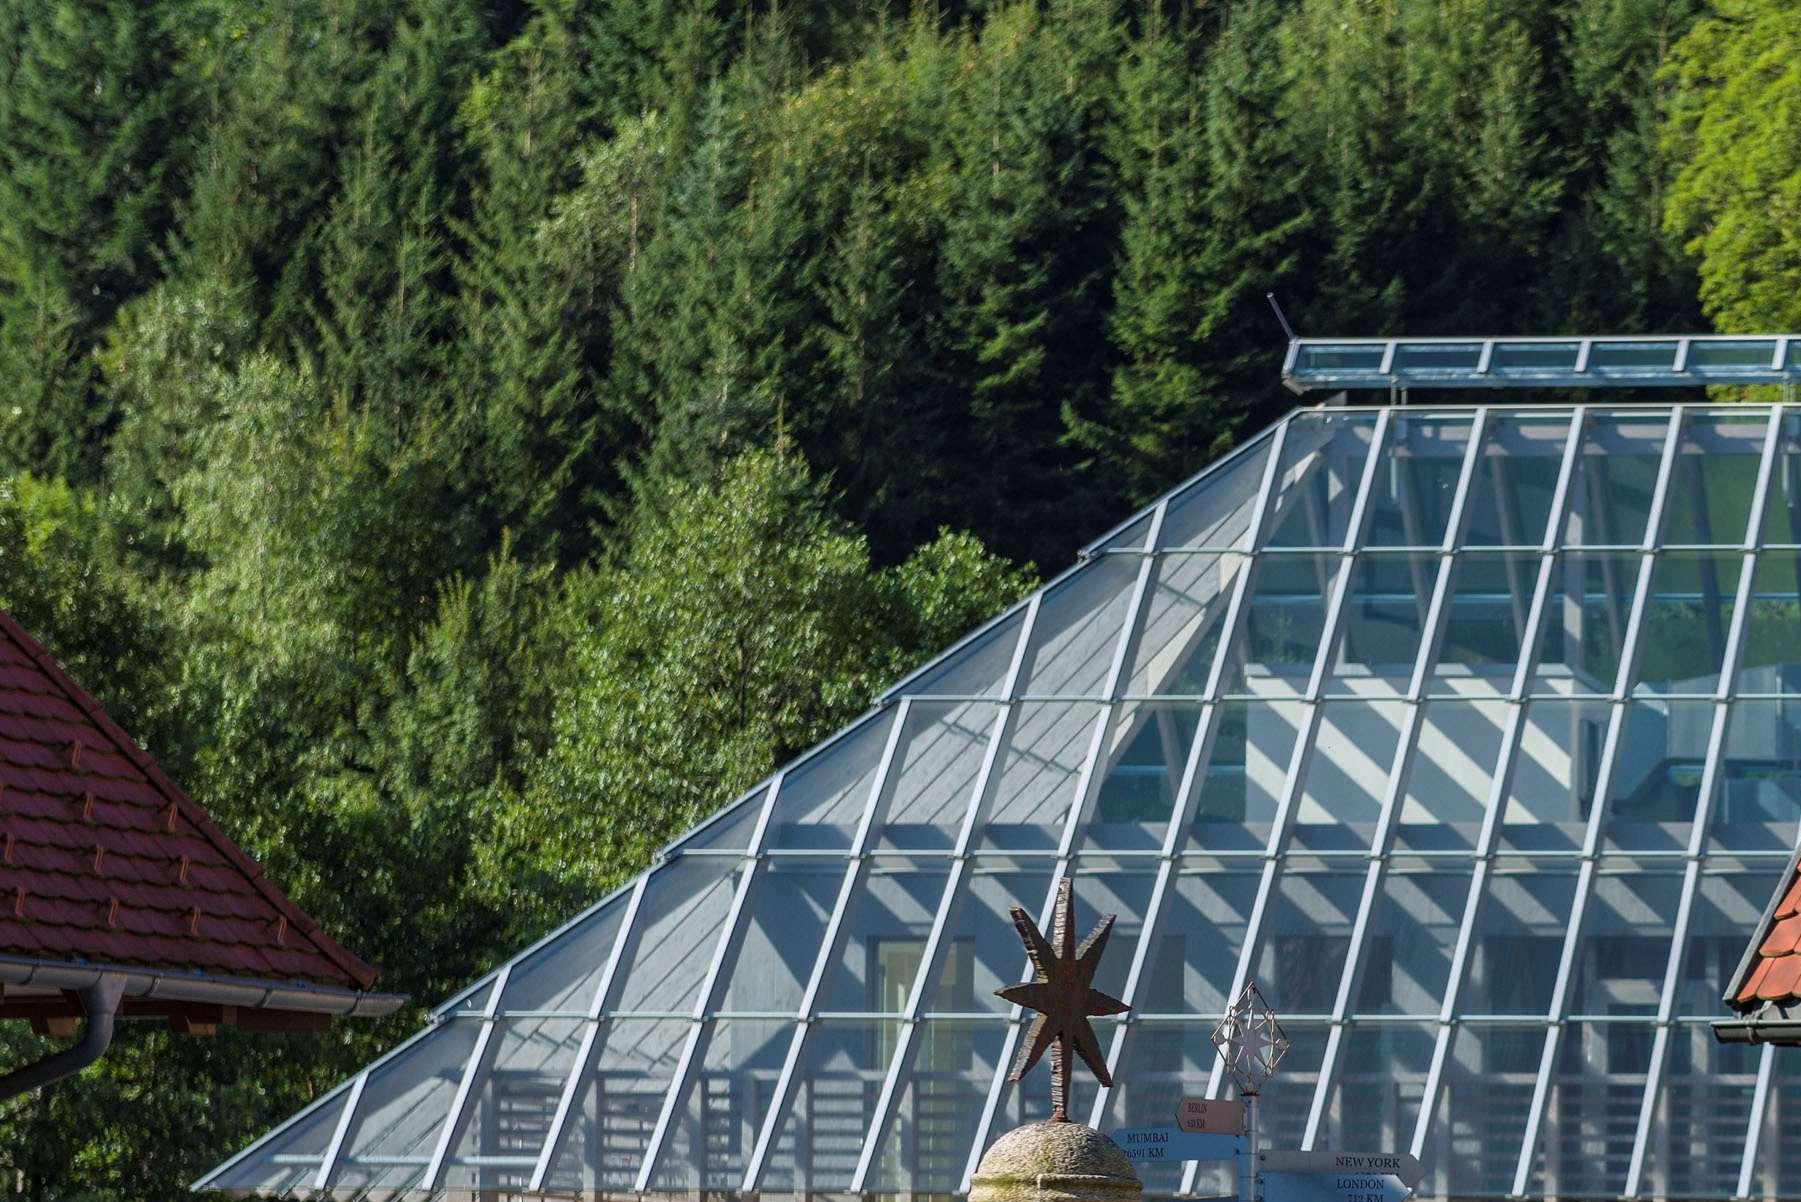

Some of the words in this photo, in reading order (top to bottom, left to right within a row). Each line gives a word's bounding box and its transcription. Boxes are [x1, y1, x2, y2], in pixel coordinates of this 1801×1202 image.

[1127, 1132, 1169, 1143] MUMBAI
[1148, 1147, 1164, 1158] KM
[1335, 1156, 1364, 1167] NEW
[1367, 1158, 1401, 1169] YORK
[1336, 1179, 1384, 1190] LONDON
